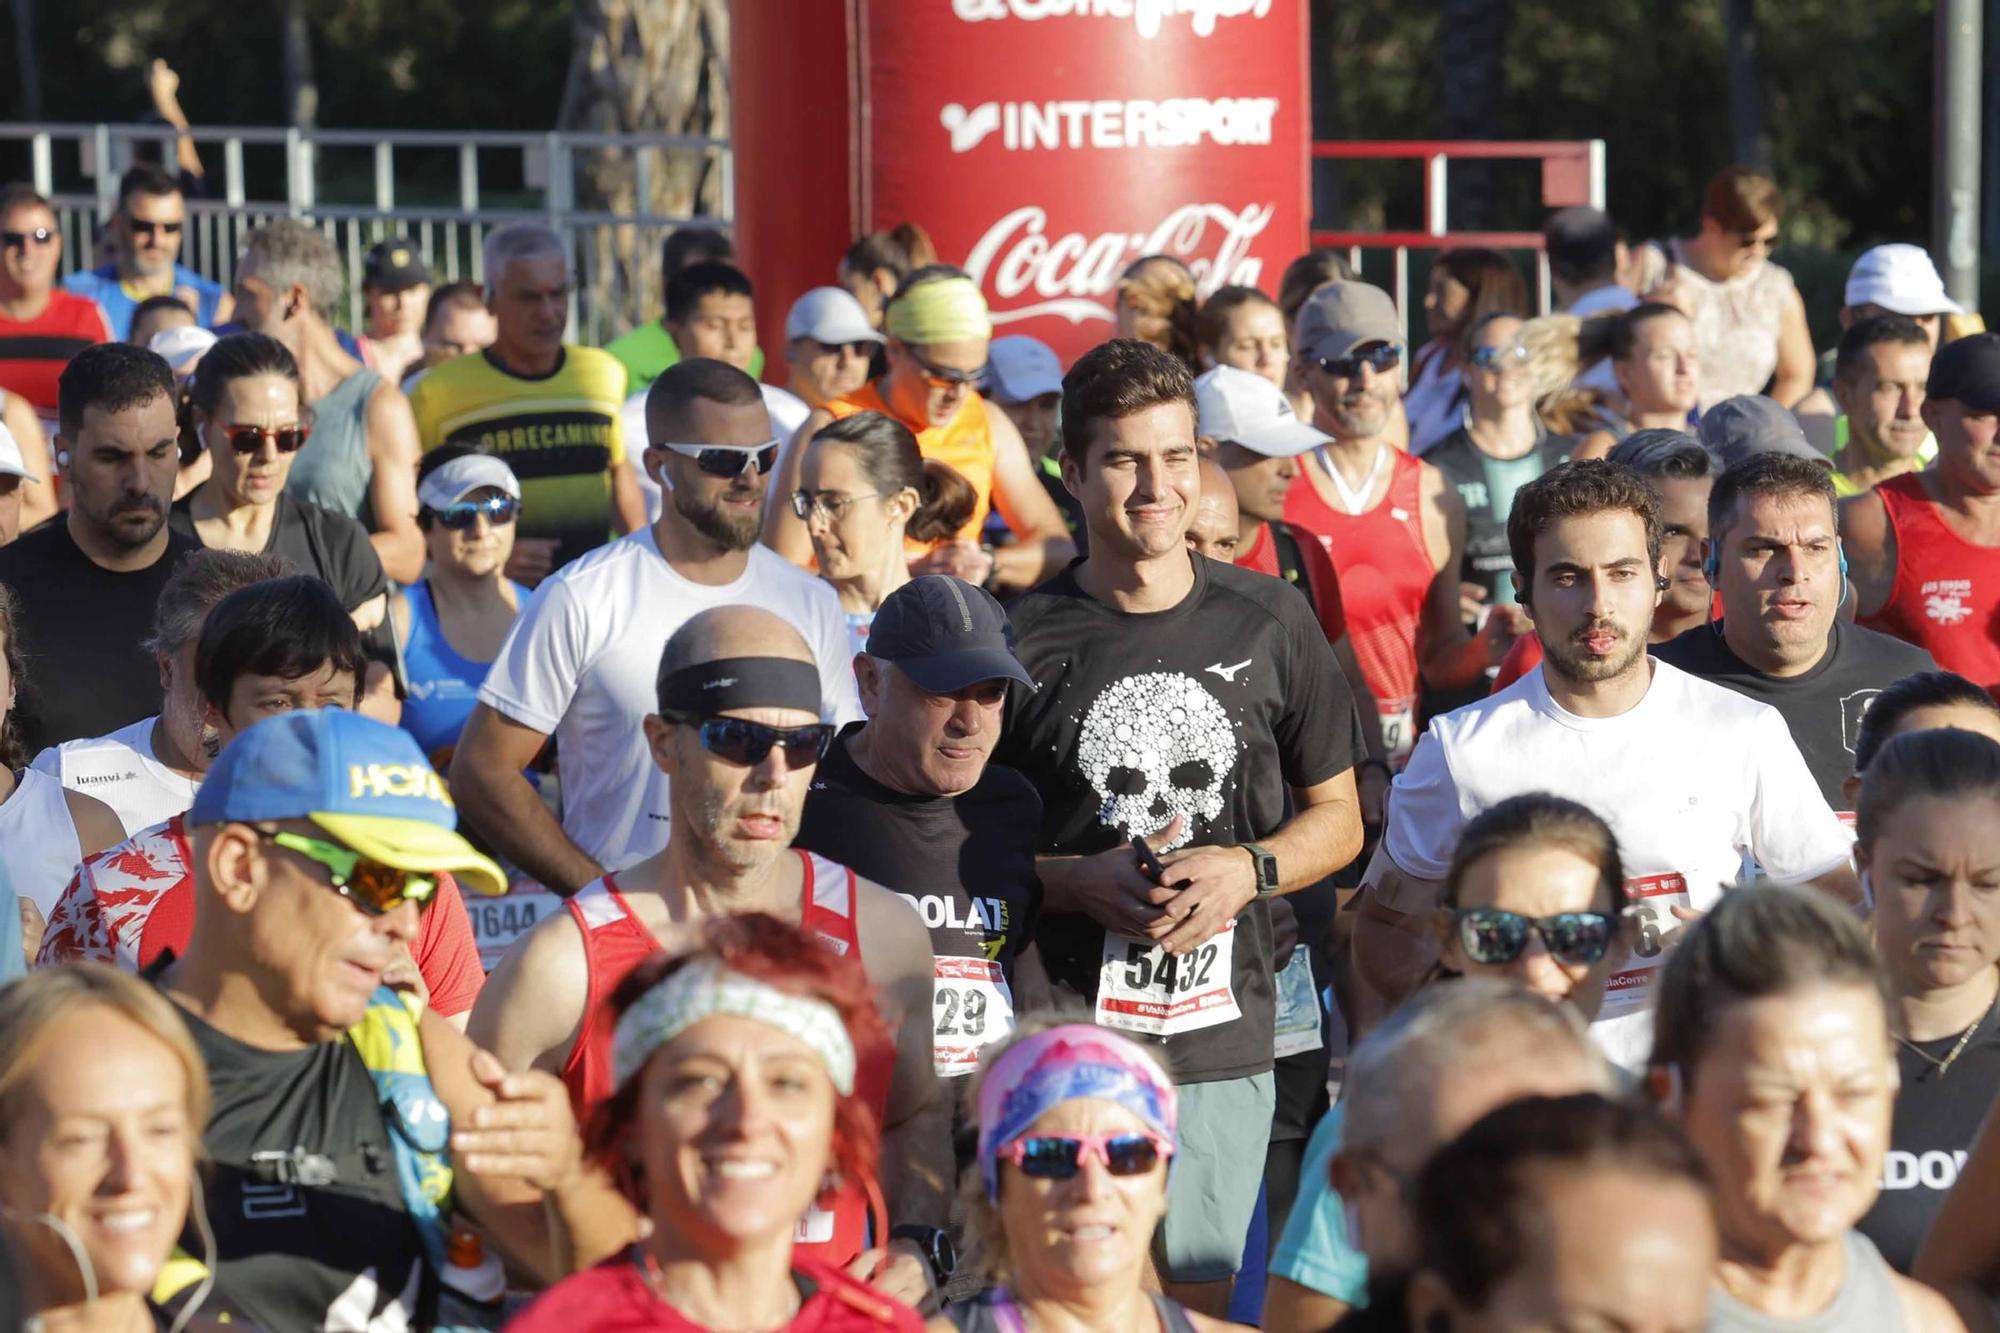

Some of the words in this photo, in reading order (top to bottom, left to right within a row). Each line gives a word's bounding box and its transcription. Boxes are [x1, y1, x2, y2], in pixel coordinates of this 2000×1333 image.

[1003, 98, 1277, 150] INTERSPORT
[76, 773, 121, 785] luanvi
[1000, 899, 1009, 931] TEAM
[1124, 943, 1218, 994] 5432
[935, 987, 987, 1036] 29
